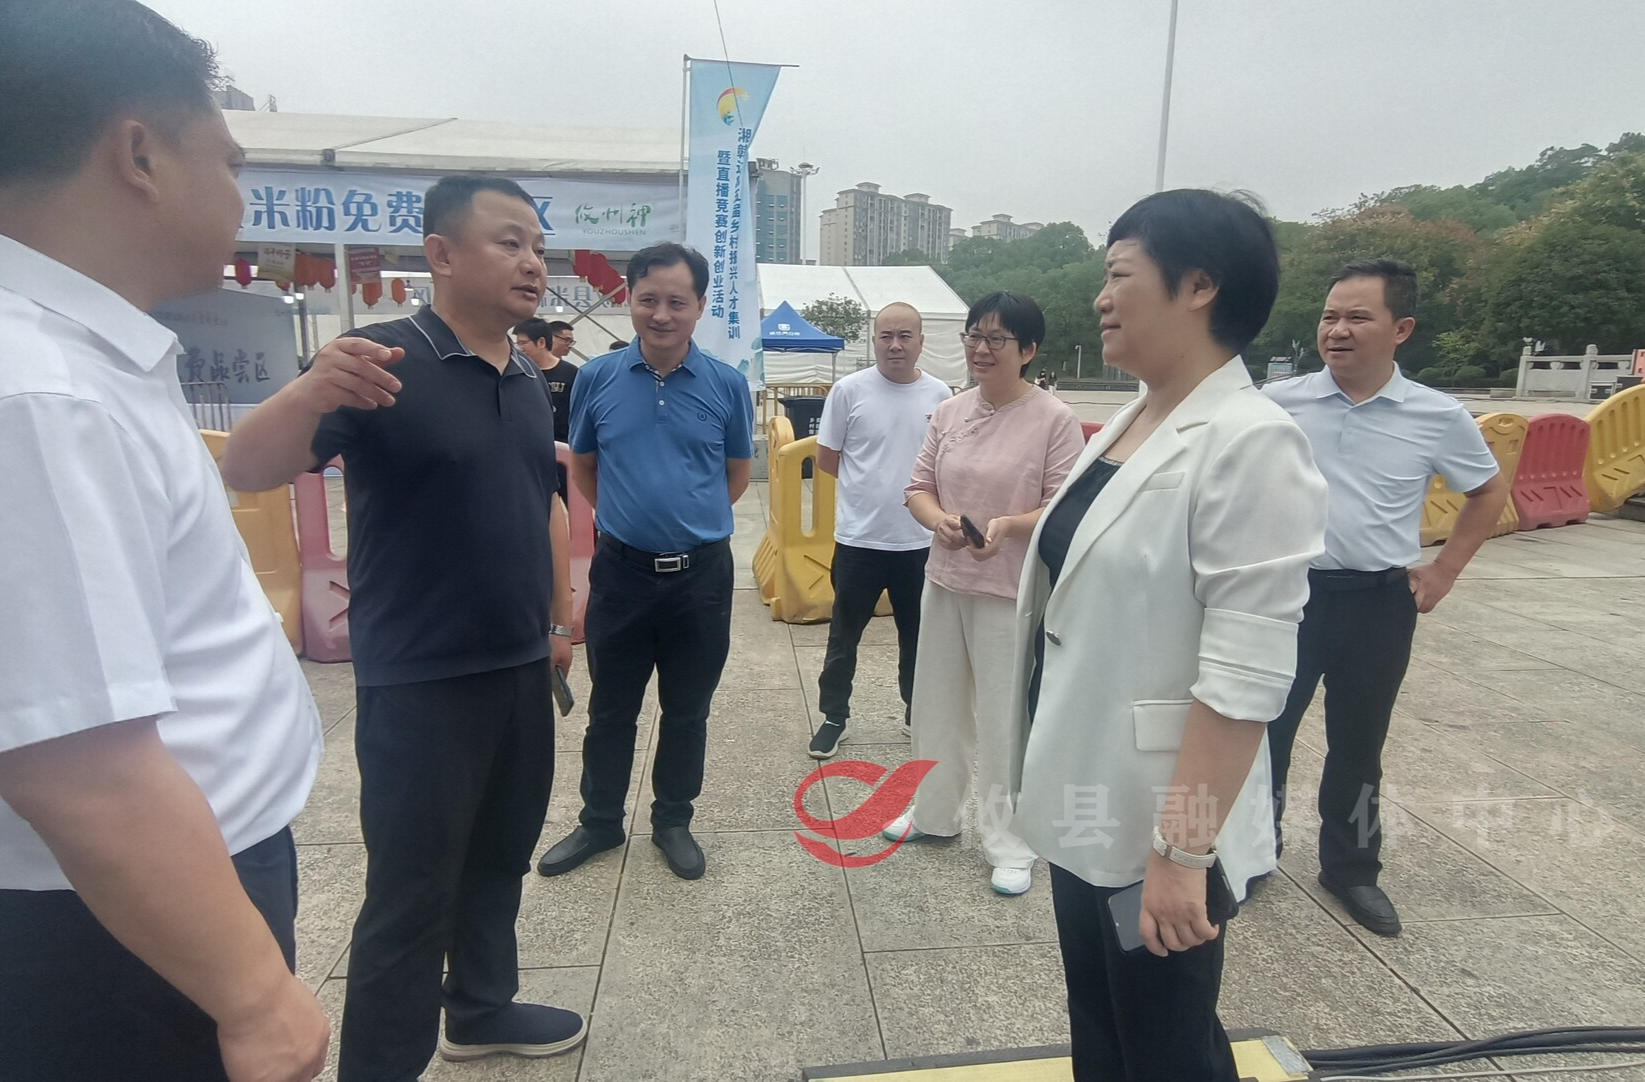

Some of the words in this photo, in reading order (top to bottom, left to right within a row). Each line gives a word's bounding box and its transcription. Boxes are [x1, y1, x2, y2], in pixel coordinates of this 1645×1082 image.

[582, 227, 647, 236] YOUZHOUSHEN
[711, 149, 732, 319] 暨直播竞赛创新创业活动
